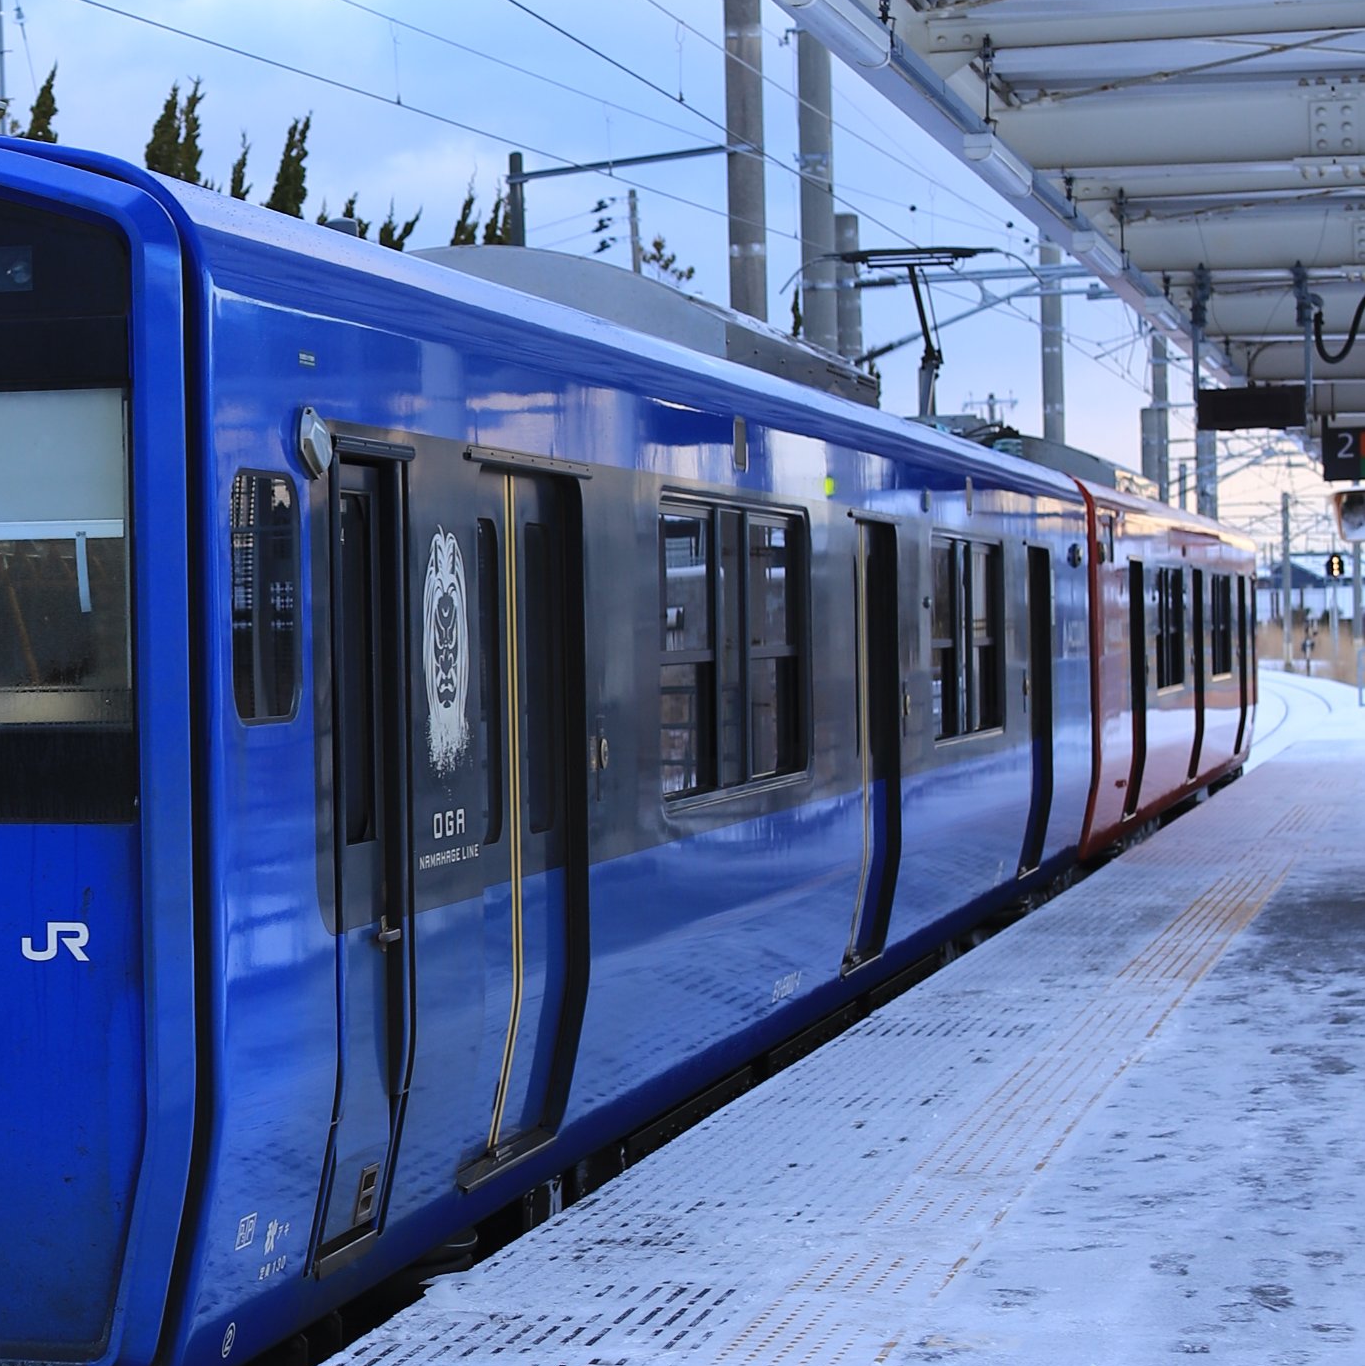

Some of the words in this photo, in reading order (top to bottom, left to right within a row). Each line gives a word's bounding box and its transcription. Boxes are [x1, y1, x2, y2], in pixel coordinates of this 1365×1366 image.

[1337, 433, 1354, 458] 2
[433, 808, 465, 839] OGA
[419, 847, 461, 870] NAMAHAGE
[461, 843, 479, 860] LINE
[21, 921, 90, 962] JR
